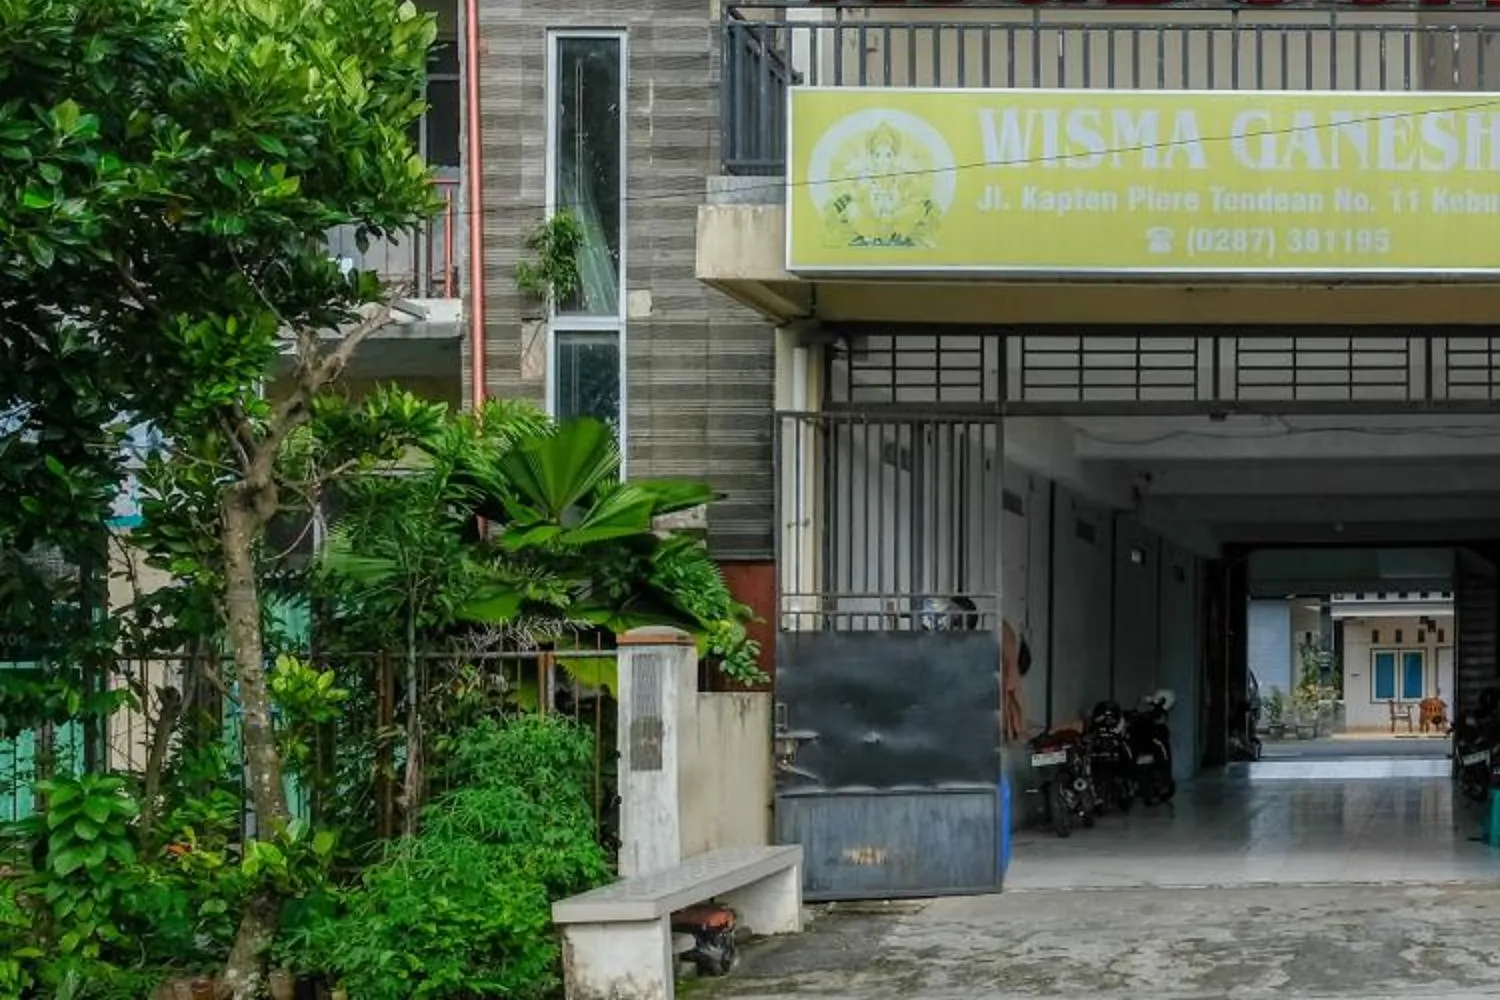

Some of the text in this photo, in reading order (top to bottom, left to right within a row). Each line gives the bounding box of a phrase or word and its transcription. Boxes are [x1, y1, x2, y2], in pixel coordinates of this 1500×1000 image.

[978, 108, 1206, 169] WISMA
[1021, 184, 1118, 216] Kapten
[1332, 187, 1376, 214] No.
[1390, 187, 1422, 214] 11
[1187, 226, 1276, 257] (0287)
